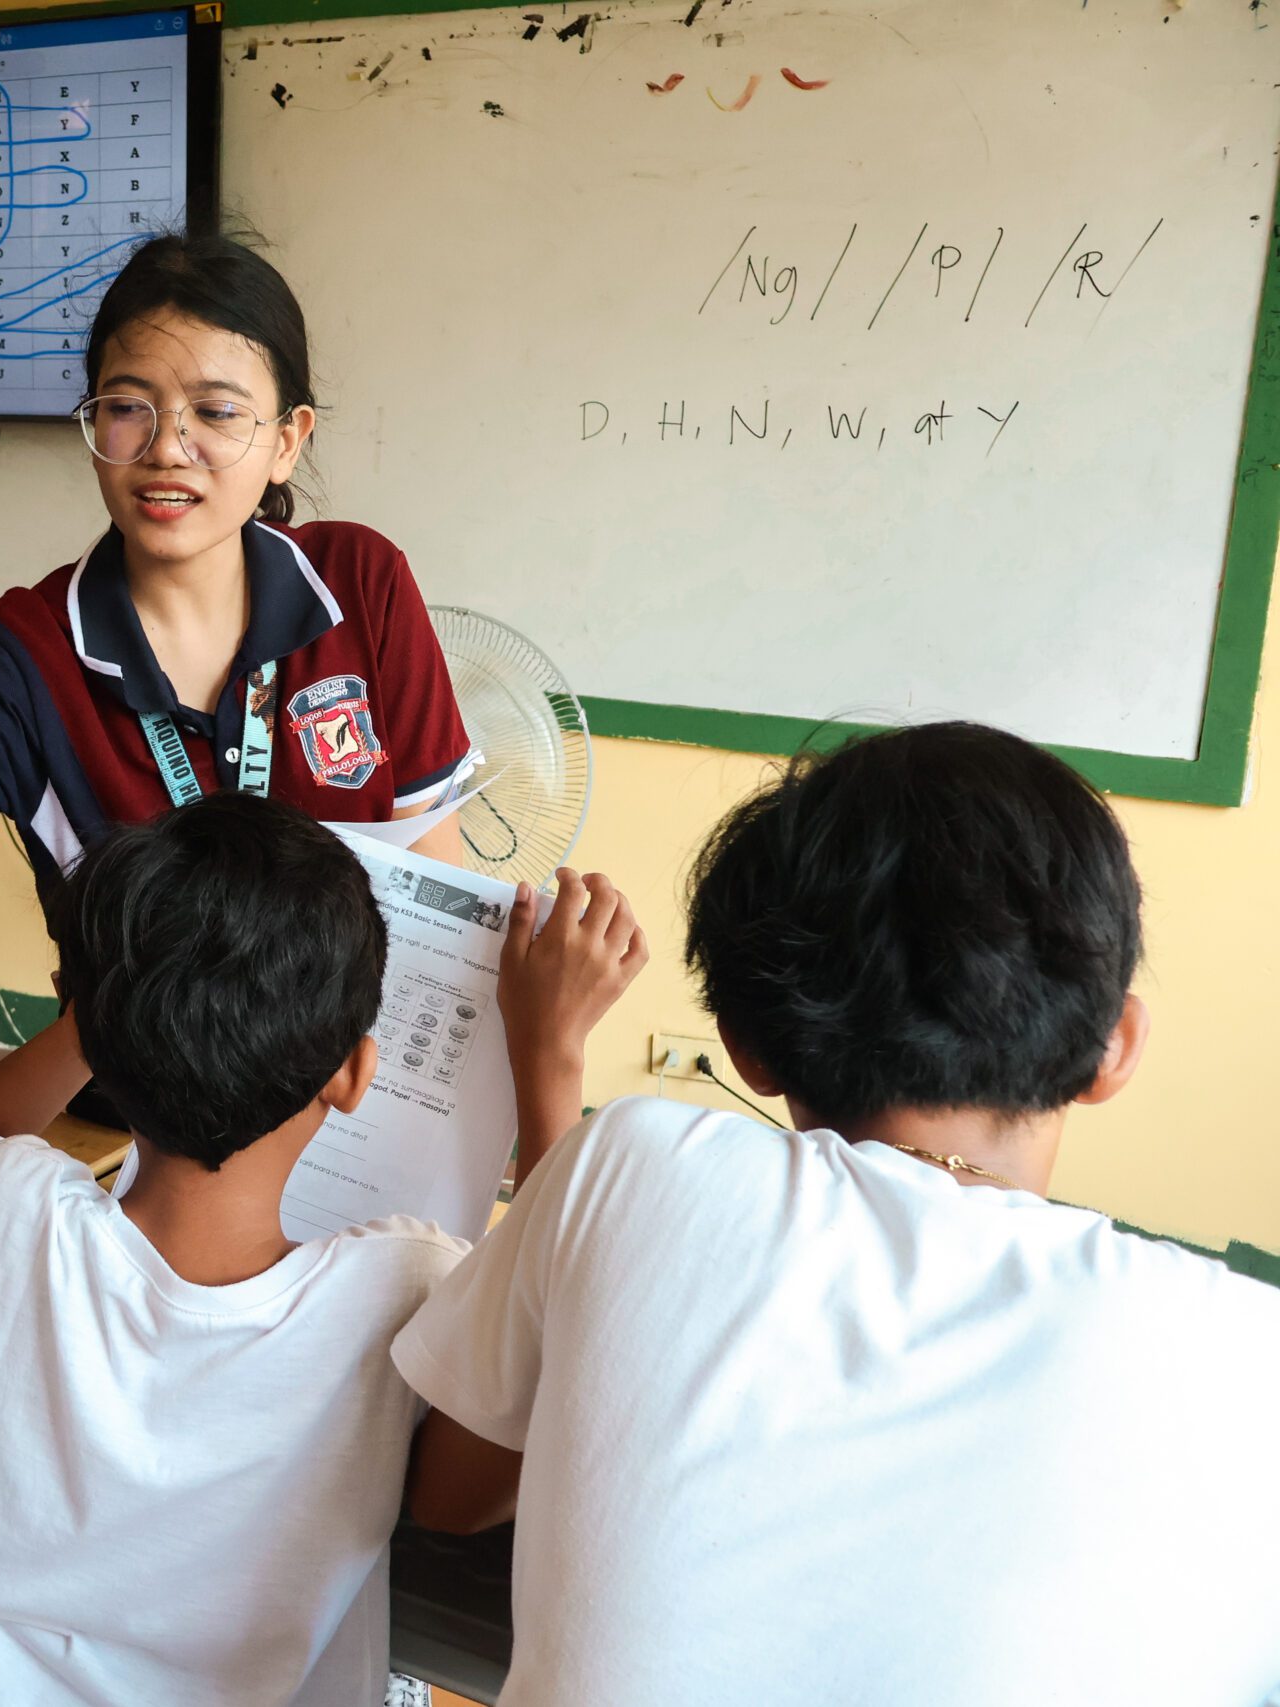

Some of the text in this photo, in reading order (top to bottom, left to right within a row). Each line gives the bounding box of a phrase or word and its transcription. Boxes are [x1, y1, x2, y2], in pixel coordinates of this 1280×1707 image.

[59, 85, 70, 99] E
[129, 80, 141, 94] Y
[59, 118, 70, 132] Y
[130, 113, 141, 127] F
[59, 150, 71, 163] X
[129, 146, 141, 160] A
[60, 182, 71, 195] N
[130, 179, 141, 192] B
[61, 213, 70, 227] Z
[129, 211, 141, 225] H
[60, 245, 71, 258] Y
[63, 276, 70, 290] I
[61, 307, 71, 320] L
[61, 338, 72, 350] A
[61, 368, 72, 381] C
[977, 401, 1019, 457] Y
[307, 679, 346, 700] ENGLISH
[299, 711, 323, 725] LOGOS
[152, 717, 191, 781] AQUINO
[179, 781, 200, 805] HI
[322, 755, 372, 778] PHILOLOGIA
[413, 913, 432, 924] Basic
[432, 920, 458, 933] Session
[390, 1089, 411, 1102] Papel
[418, 1100, 450, 1117] masaya)
[322, 1121, 338, 1132] nay
[337, 1126, 349, 1135] mo
[313, 1164, 331, 1175] para
[340, 1175, 358, 1185] araw
[358, 1181, 369, 1189] na
